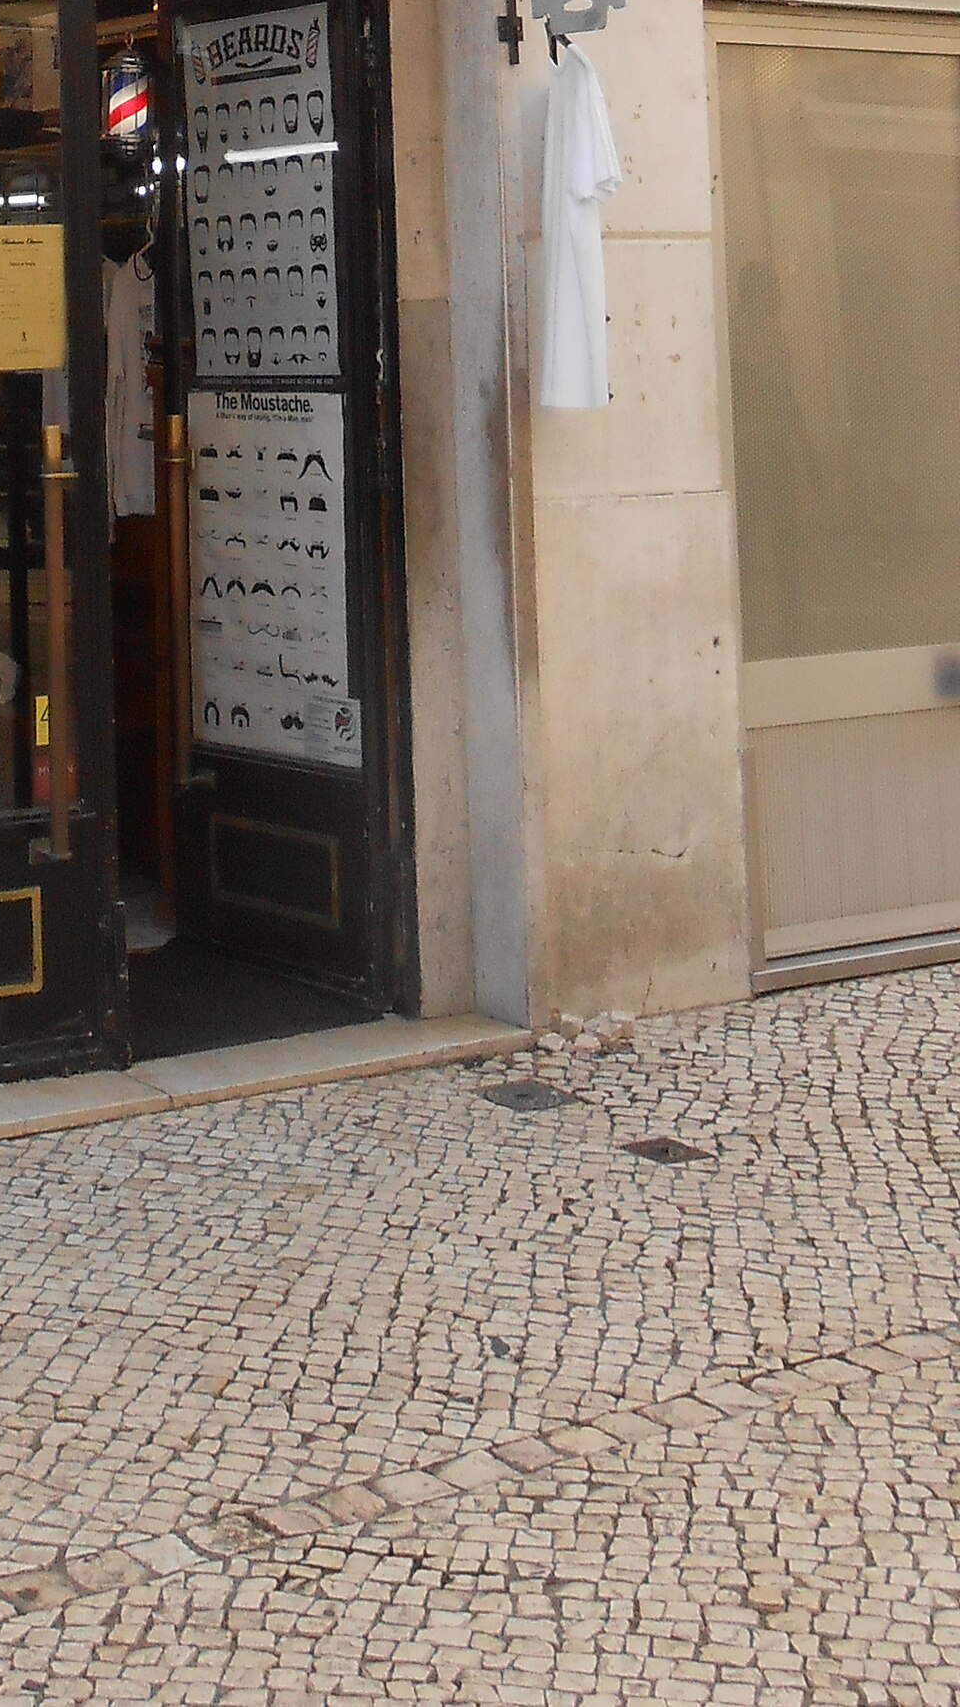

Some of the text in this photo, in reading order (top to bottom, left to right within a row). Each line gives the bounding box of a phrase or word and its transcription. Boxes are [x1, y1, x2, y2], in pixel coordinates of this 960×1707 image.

[205, 23, 304, 72] BEARDS
[215, 393, 314, 414] The Moustache.
